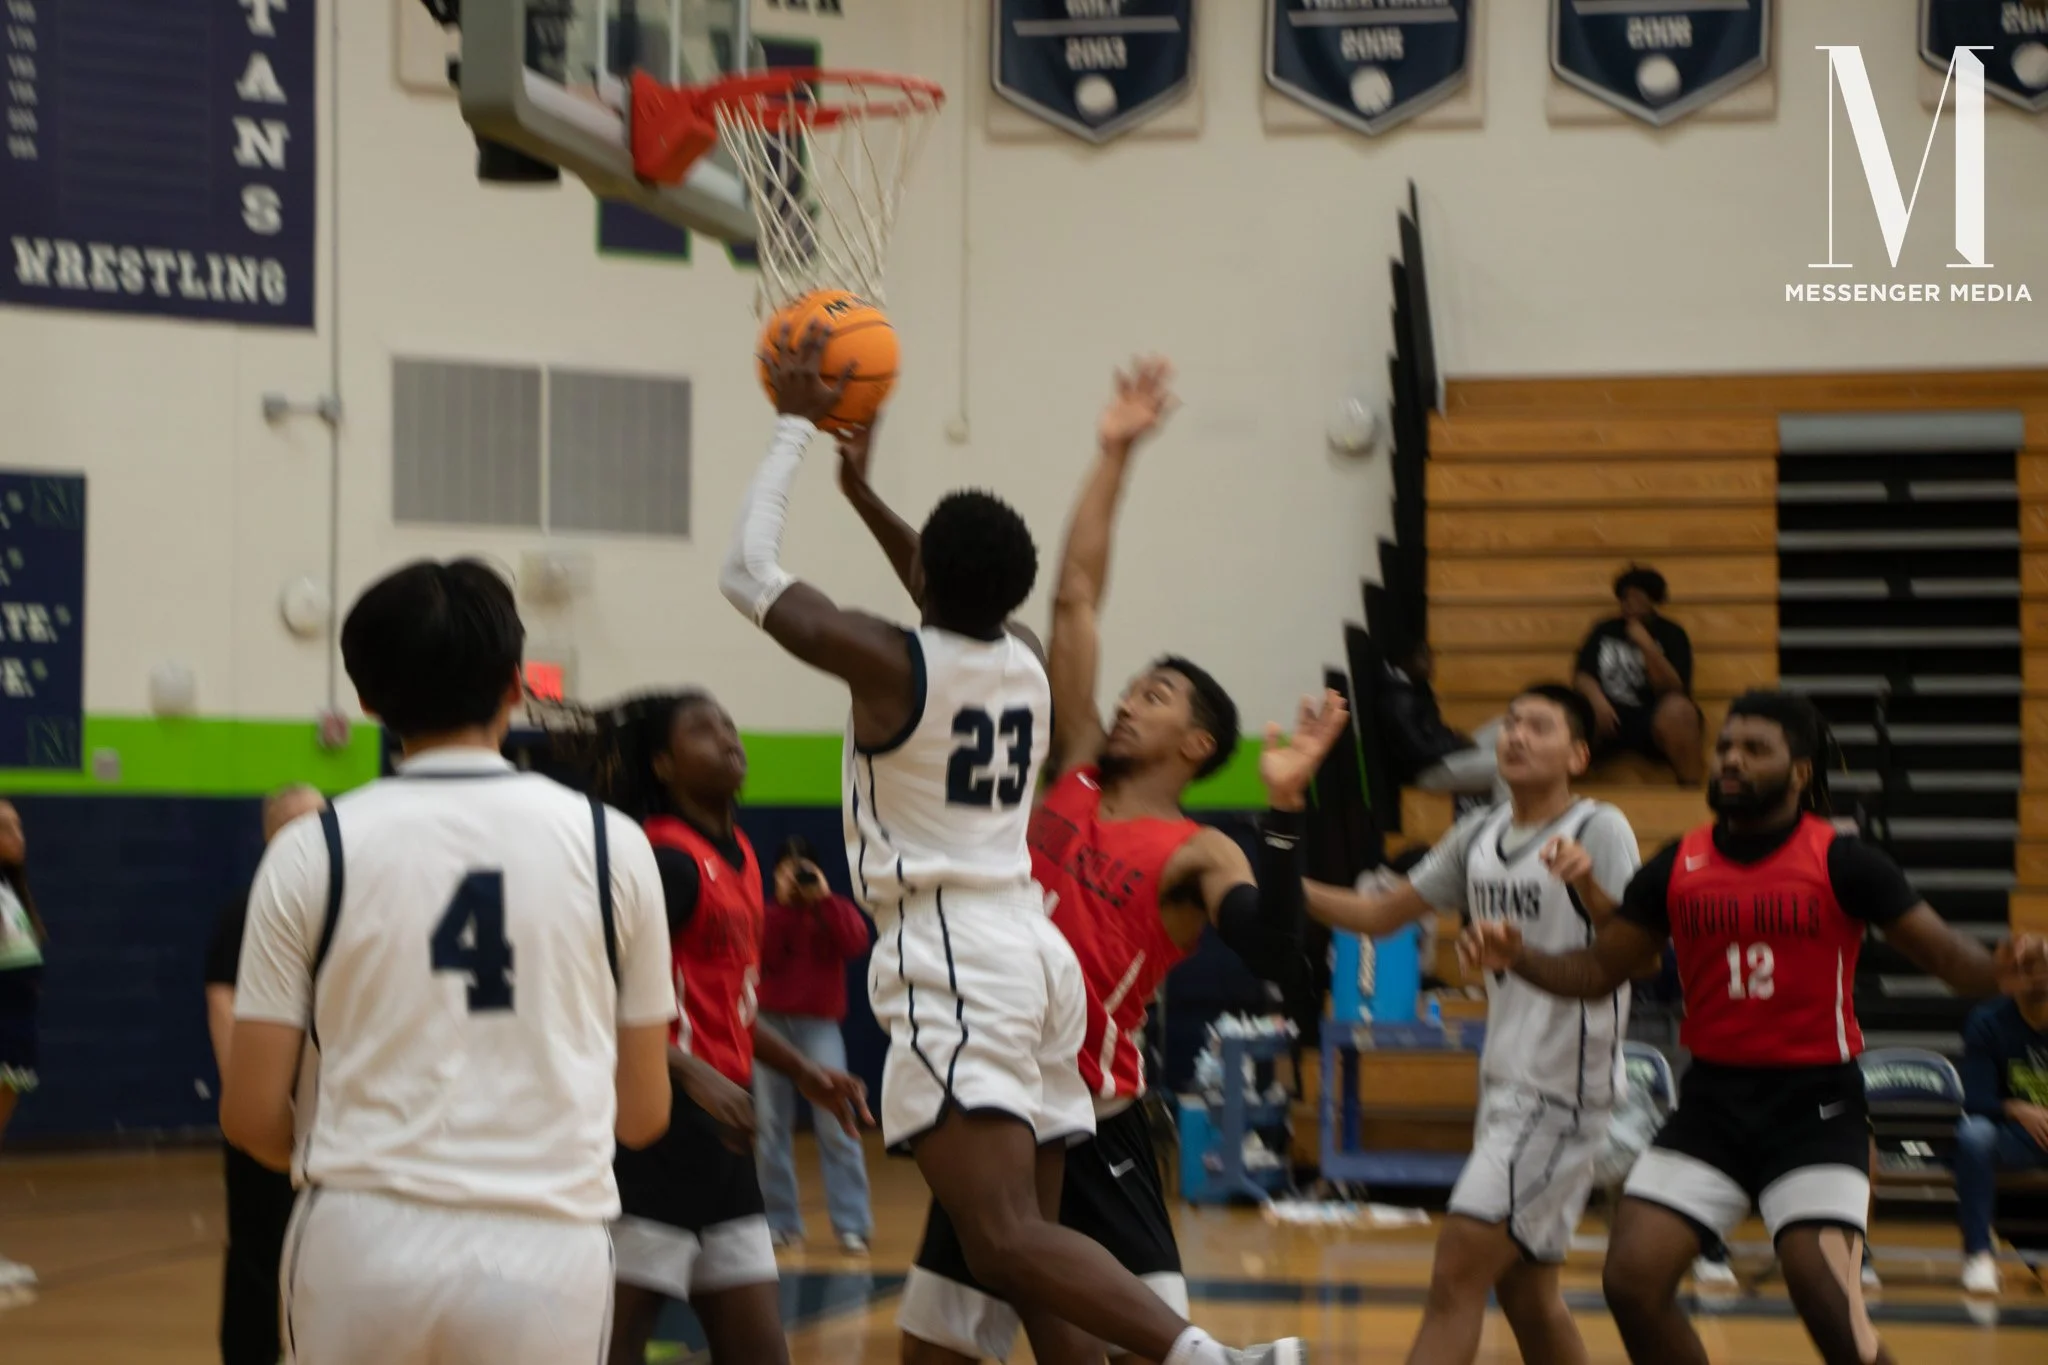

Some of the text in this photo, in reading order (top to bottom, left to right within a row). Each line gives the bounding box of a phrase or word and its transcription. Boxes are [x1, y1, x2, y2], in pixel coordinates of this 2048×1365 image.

[10, 234, 287, 306] WRESTLING
[946, 706, 1034, 808] 23
[1471, 879, 1541, 922] TITANS
[1753, 891, 1821, 940] HILLS
[429, 868, 515, 1014] 4
[1726, 941, 1775, 1001] 12
